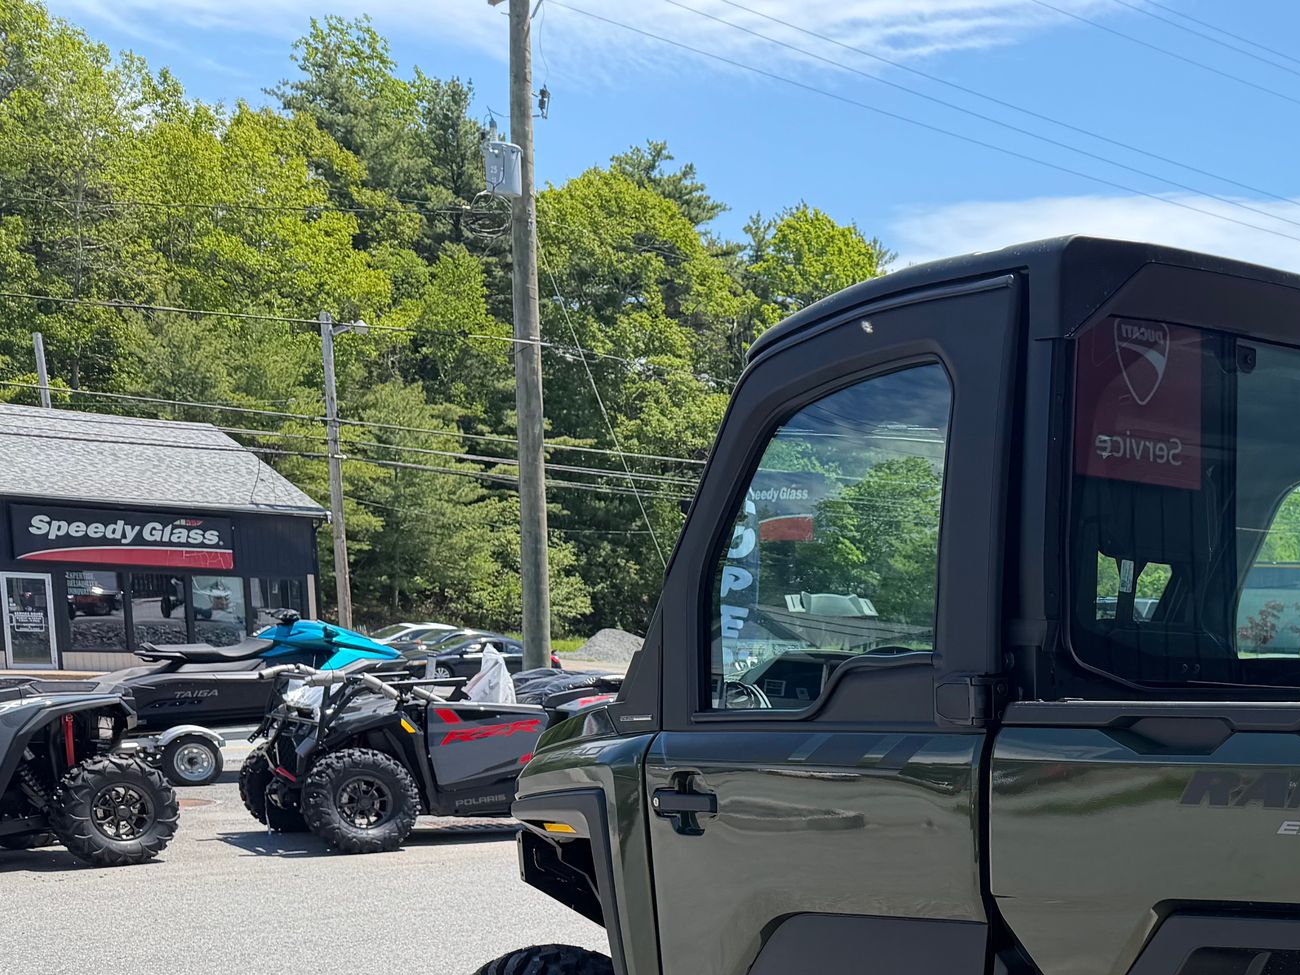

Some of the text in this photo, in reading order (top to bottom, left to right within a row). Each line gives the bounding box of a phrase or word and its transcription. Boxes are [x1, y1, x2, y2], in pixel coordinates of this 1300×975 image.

[779, 486, 809, 500] Glass
[28, 514, 220, 545] Speedy Glass
[174, 689, 219, 699] TAIGA
[456, 794, 507, 808] POLARIS
